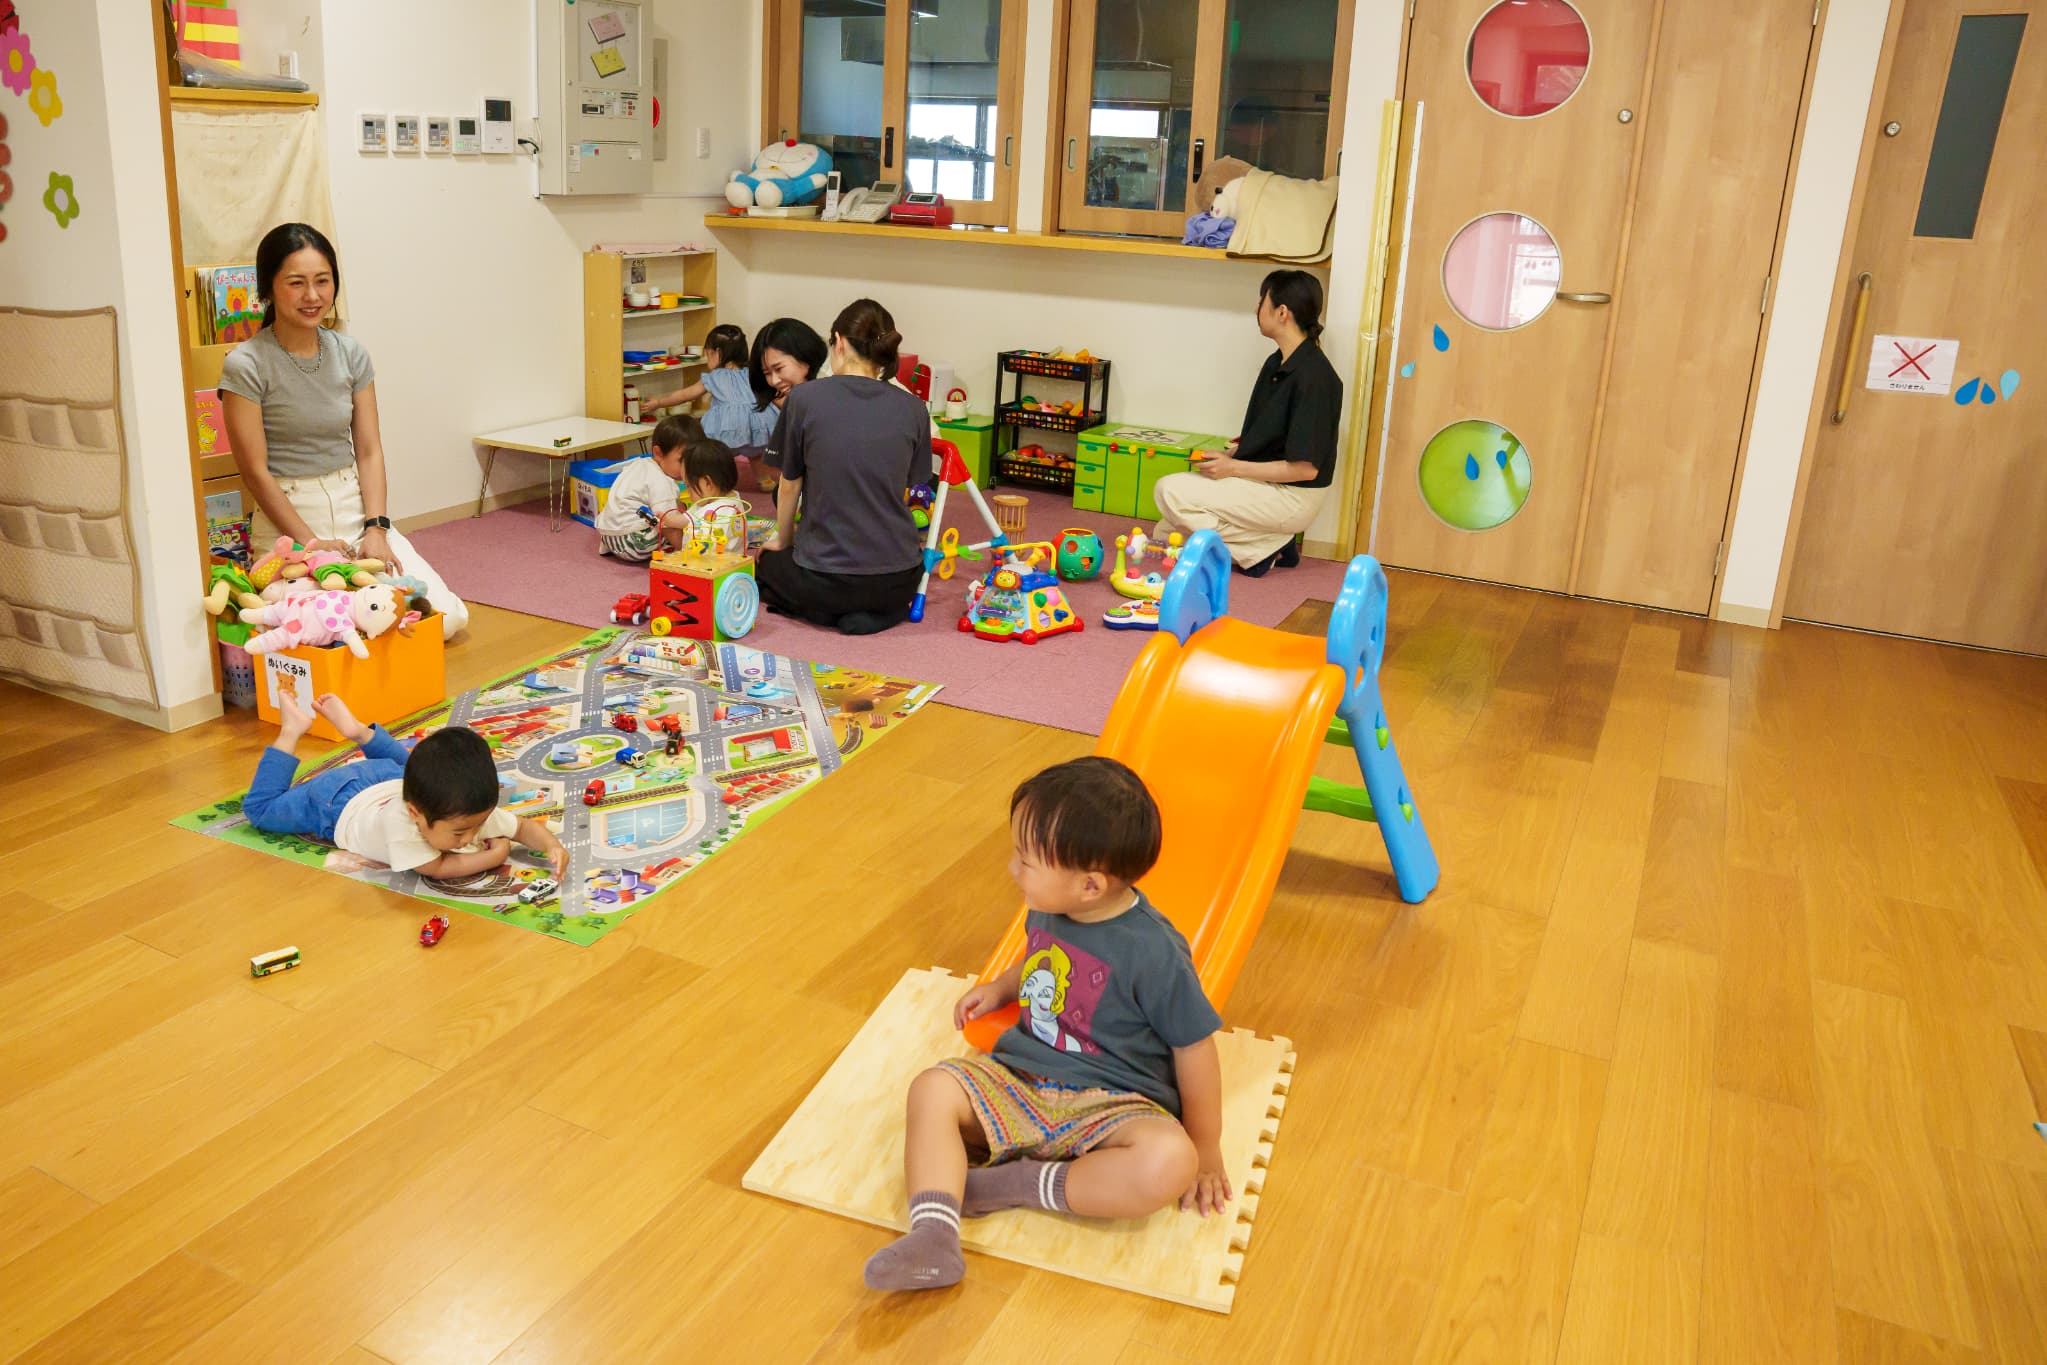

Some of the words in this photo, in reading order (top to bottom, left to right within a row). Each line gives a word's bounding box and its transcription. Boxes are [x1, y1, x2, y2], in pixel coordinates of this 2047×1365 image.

[1889, 382, 1926, 392] さわりません
[268, 657, 307, 677] ぬいぐるみ
